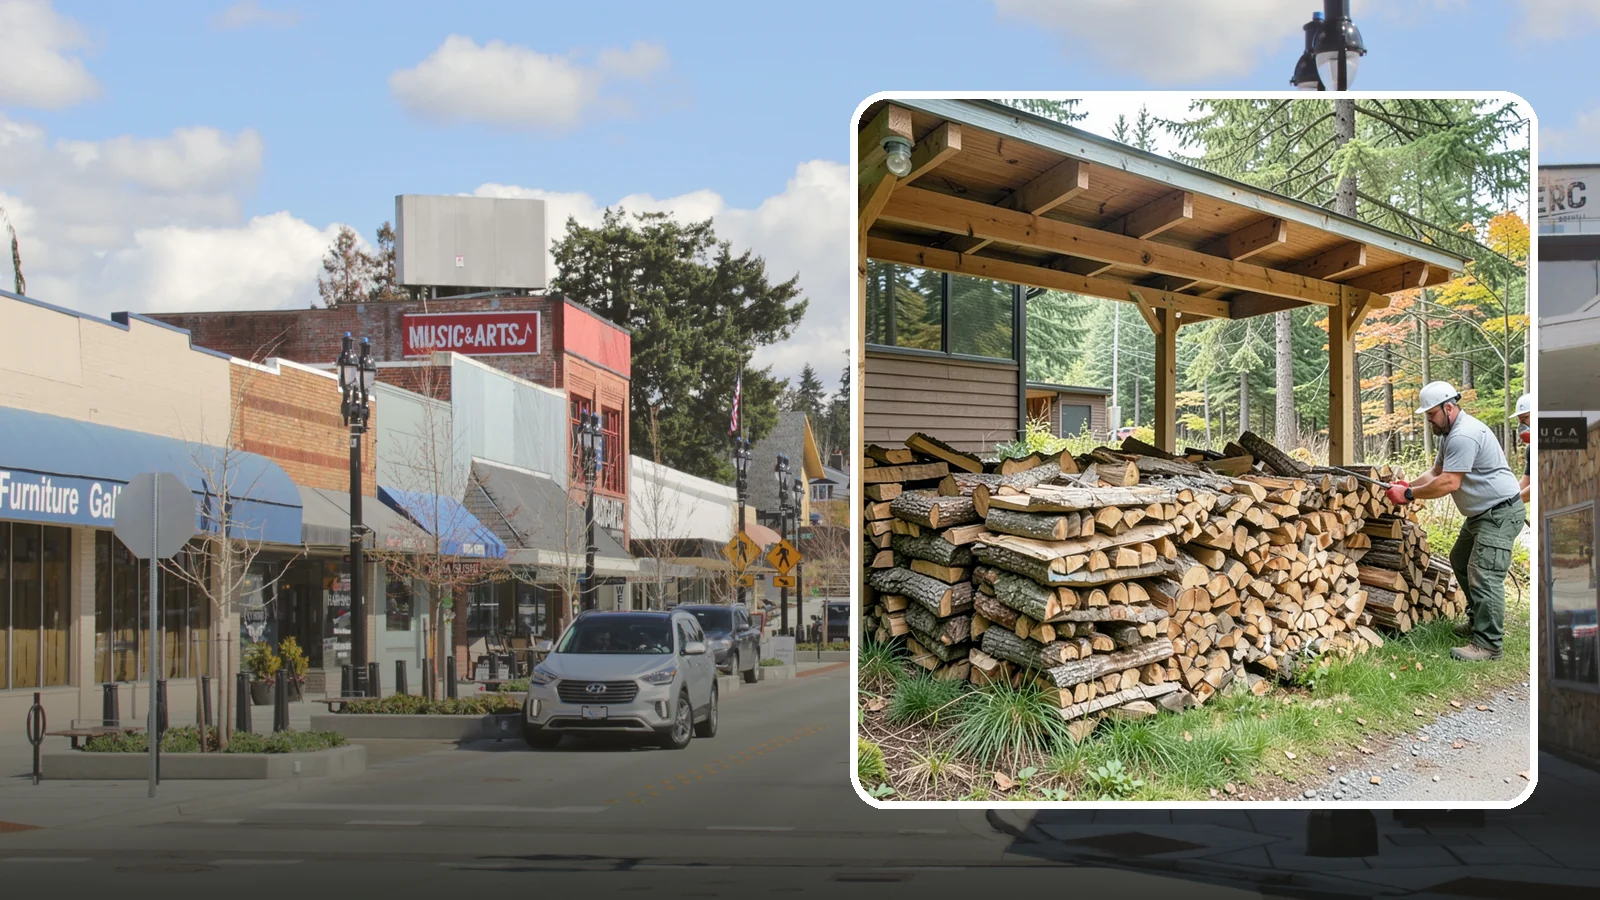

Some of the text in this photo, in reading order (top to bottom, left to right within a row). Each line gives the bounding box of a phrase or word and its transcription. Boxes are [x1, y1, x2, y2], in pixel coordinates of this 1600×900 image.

[1538, 181, 1587, 213] ERC
[408, 323, 520, 349] MUSIC&ARTS
[1540, 427, 1578, 437] UGA
[0, 471, 122, 519] Furniture Gal
[453, 563, 479, 574] SUSHI
